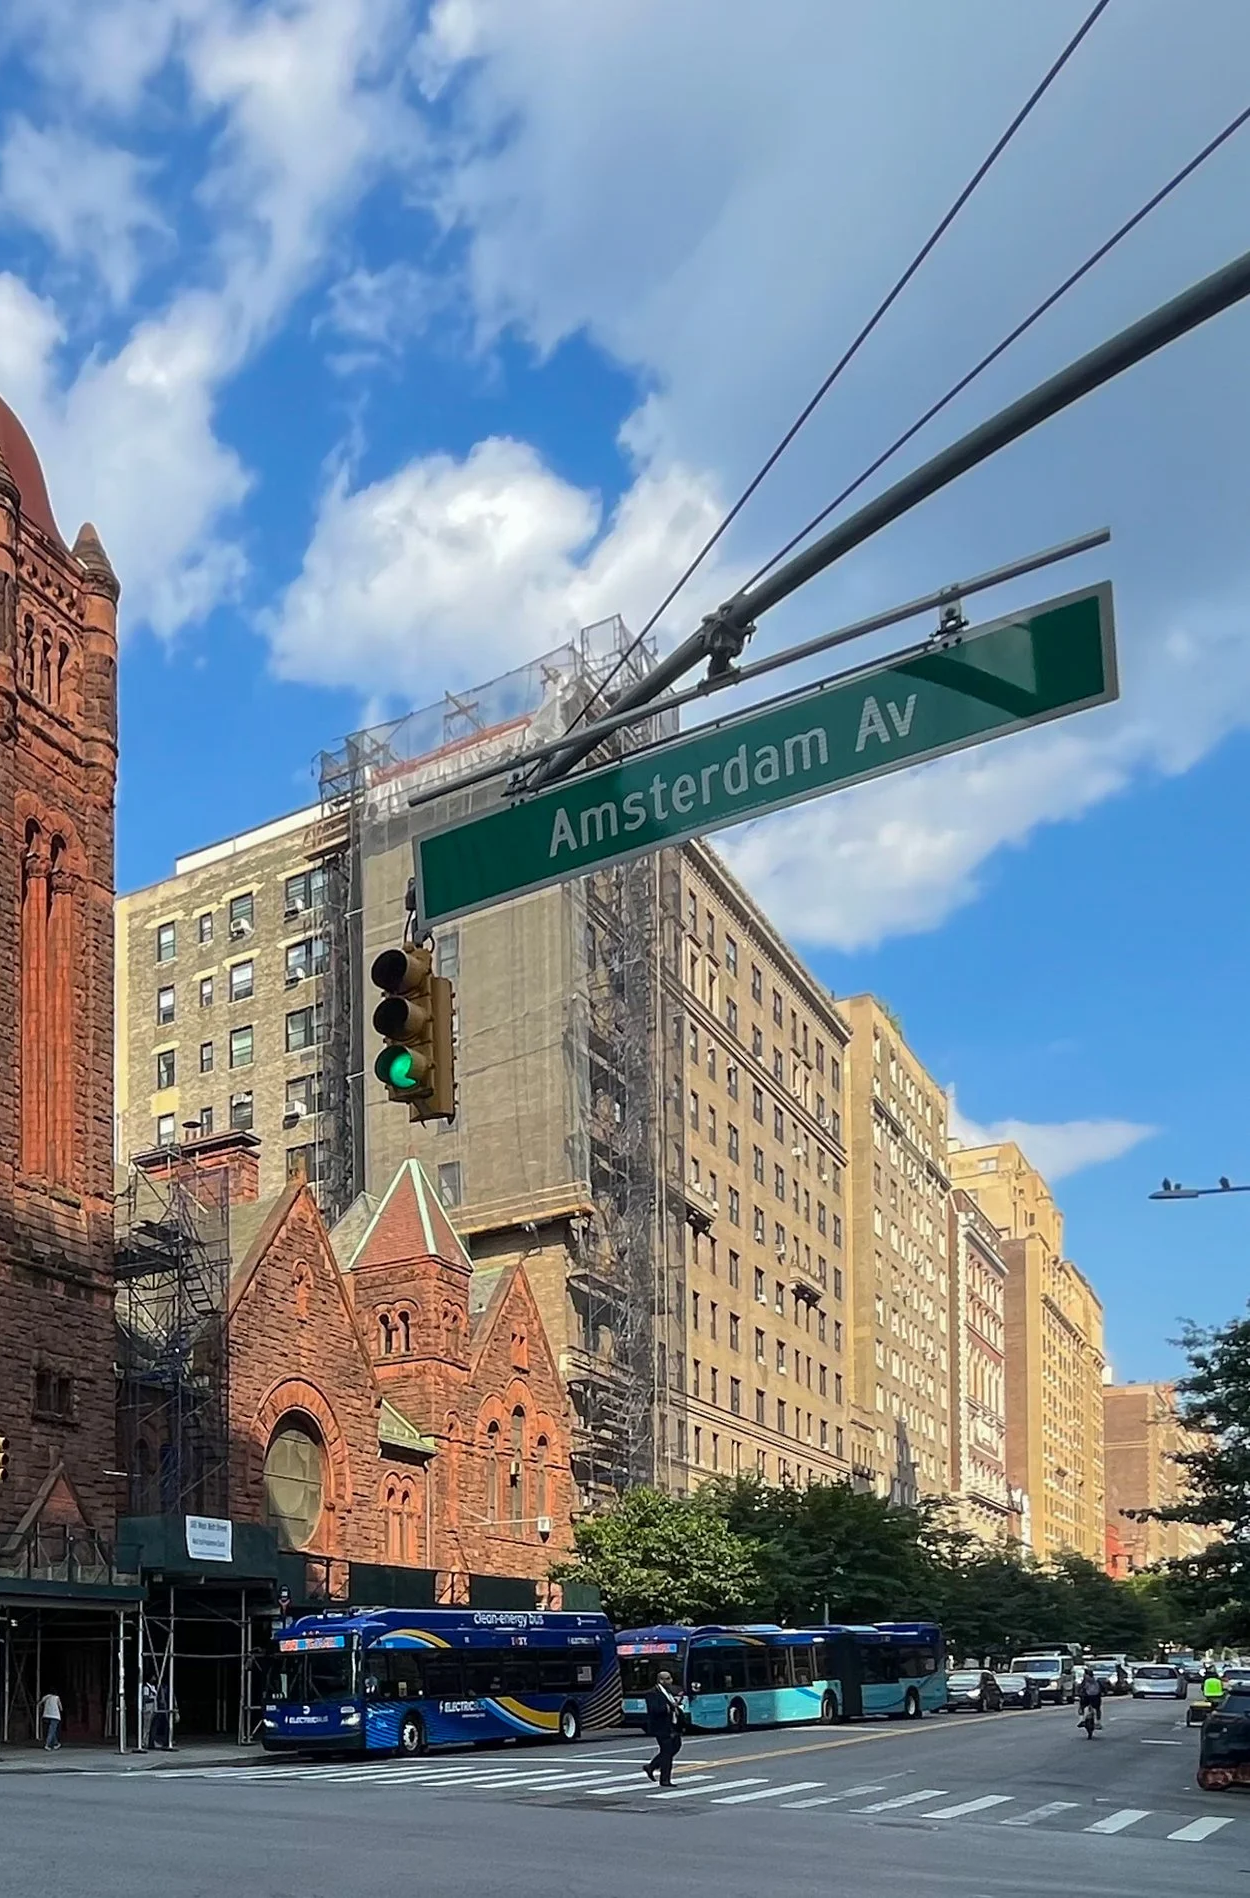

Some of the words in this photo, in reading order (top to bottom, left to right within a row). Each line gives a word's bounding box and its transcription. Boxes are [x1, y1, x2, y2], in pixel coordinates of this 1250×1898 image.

[549, 725, 829, 858] Amsterdam
[855, 691, 918, 754] Av
[473, 1612, 528, 1627] clean-energy
[528, 1613, 544, 1625] bus
